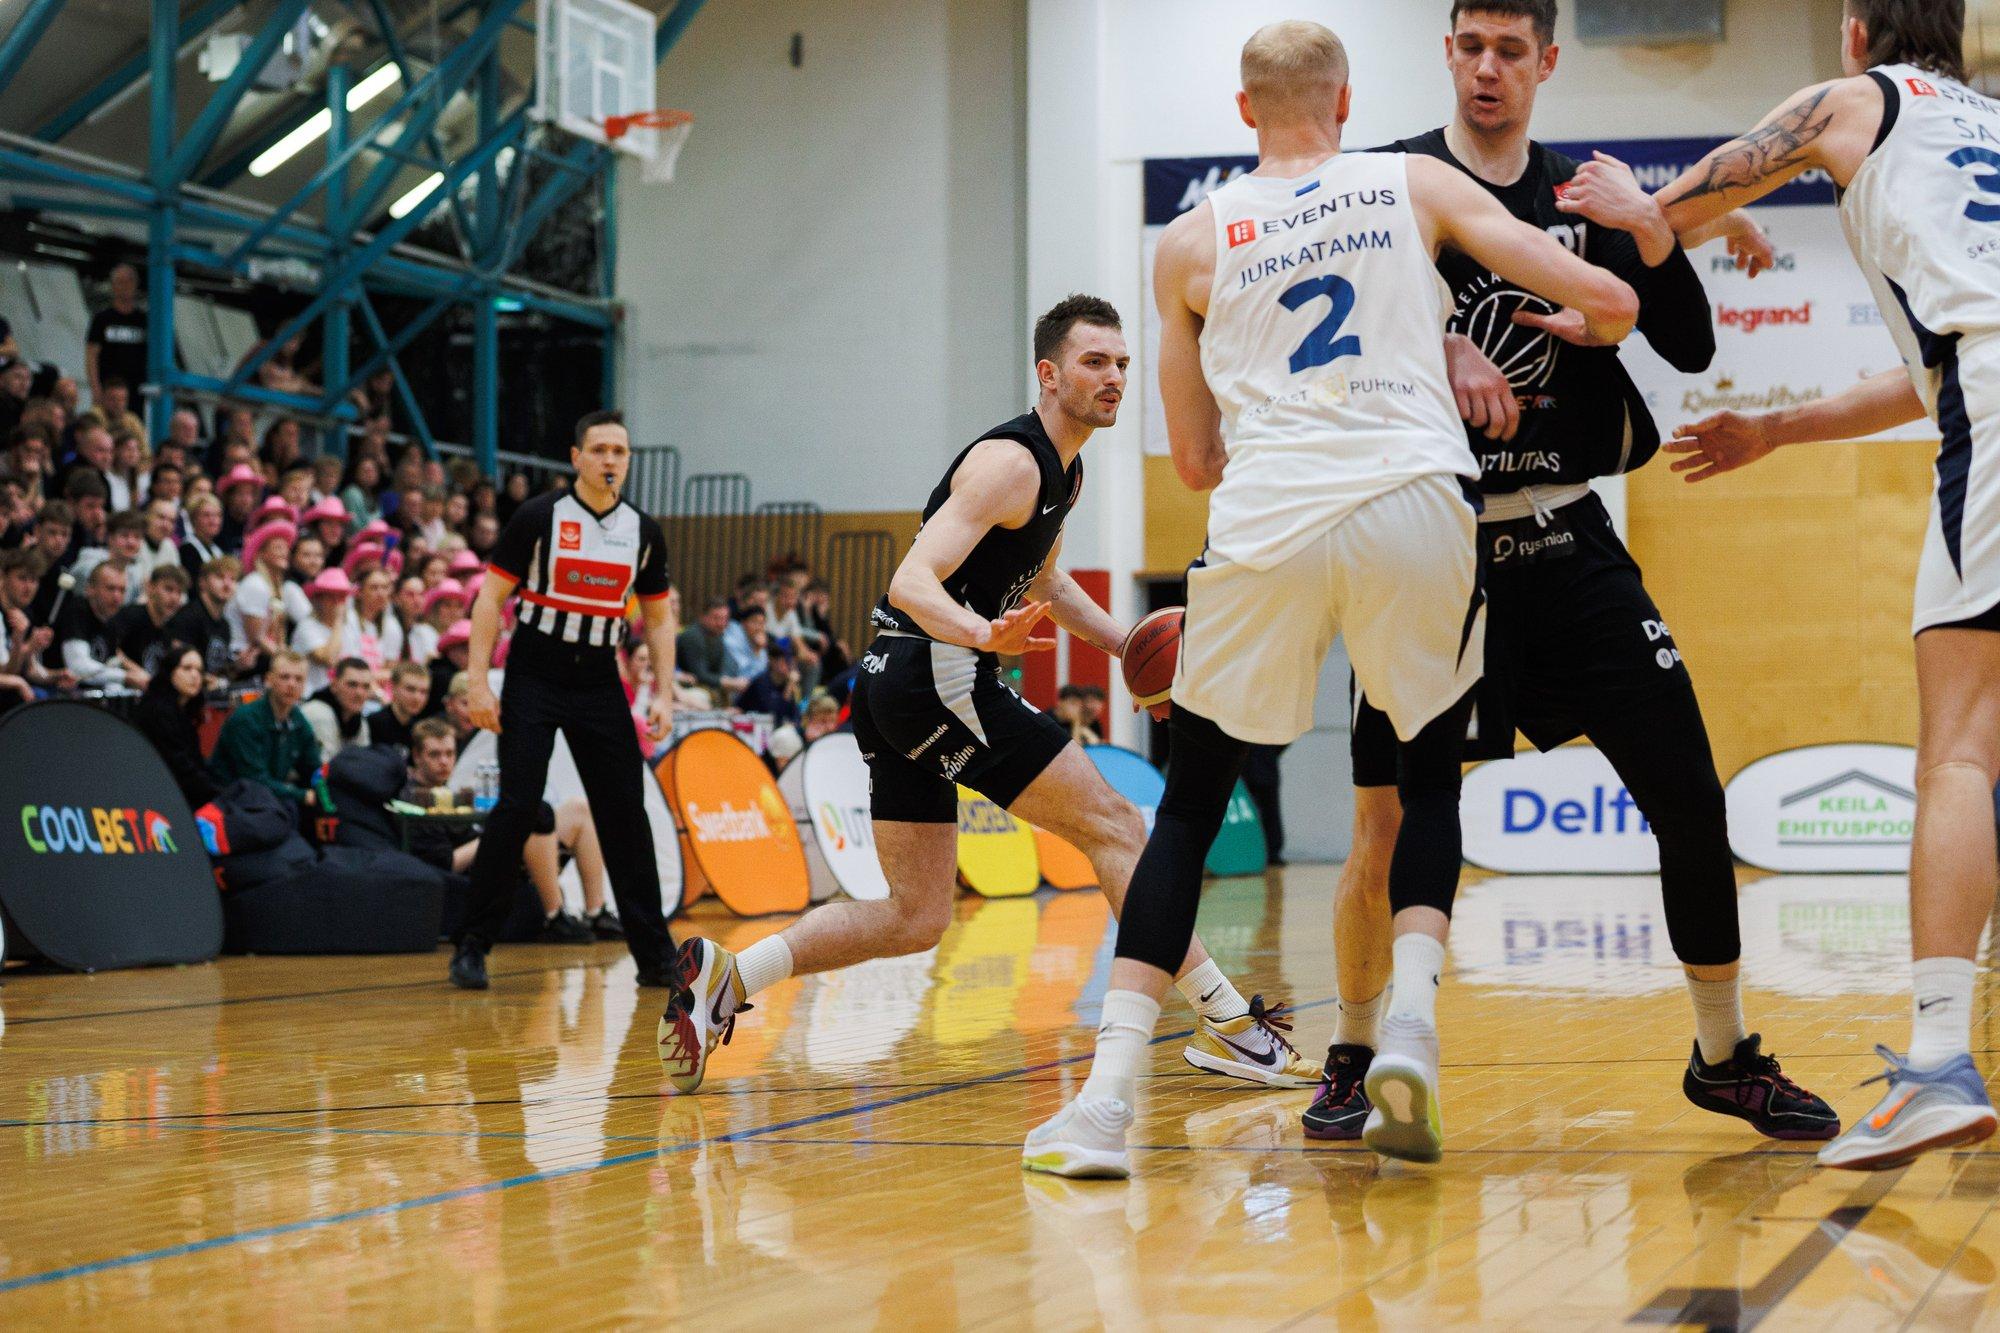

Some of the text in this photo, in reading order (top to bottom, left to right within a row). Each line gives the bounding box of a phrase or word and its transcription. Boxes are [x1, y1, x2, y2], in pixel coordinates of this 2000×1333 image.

[1262, 190, 1396, 234] EVENTUS
[1239, 230, 1392, 290] JURKATAMM
[1278, 274, 1362, 374] 2
[1717, 301, 1810, 334] legrand
[1819, 797, 1887, 812] KEILA
[21, 804, 145, 854] COOLBET
